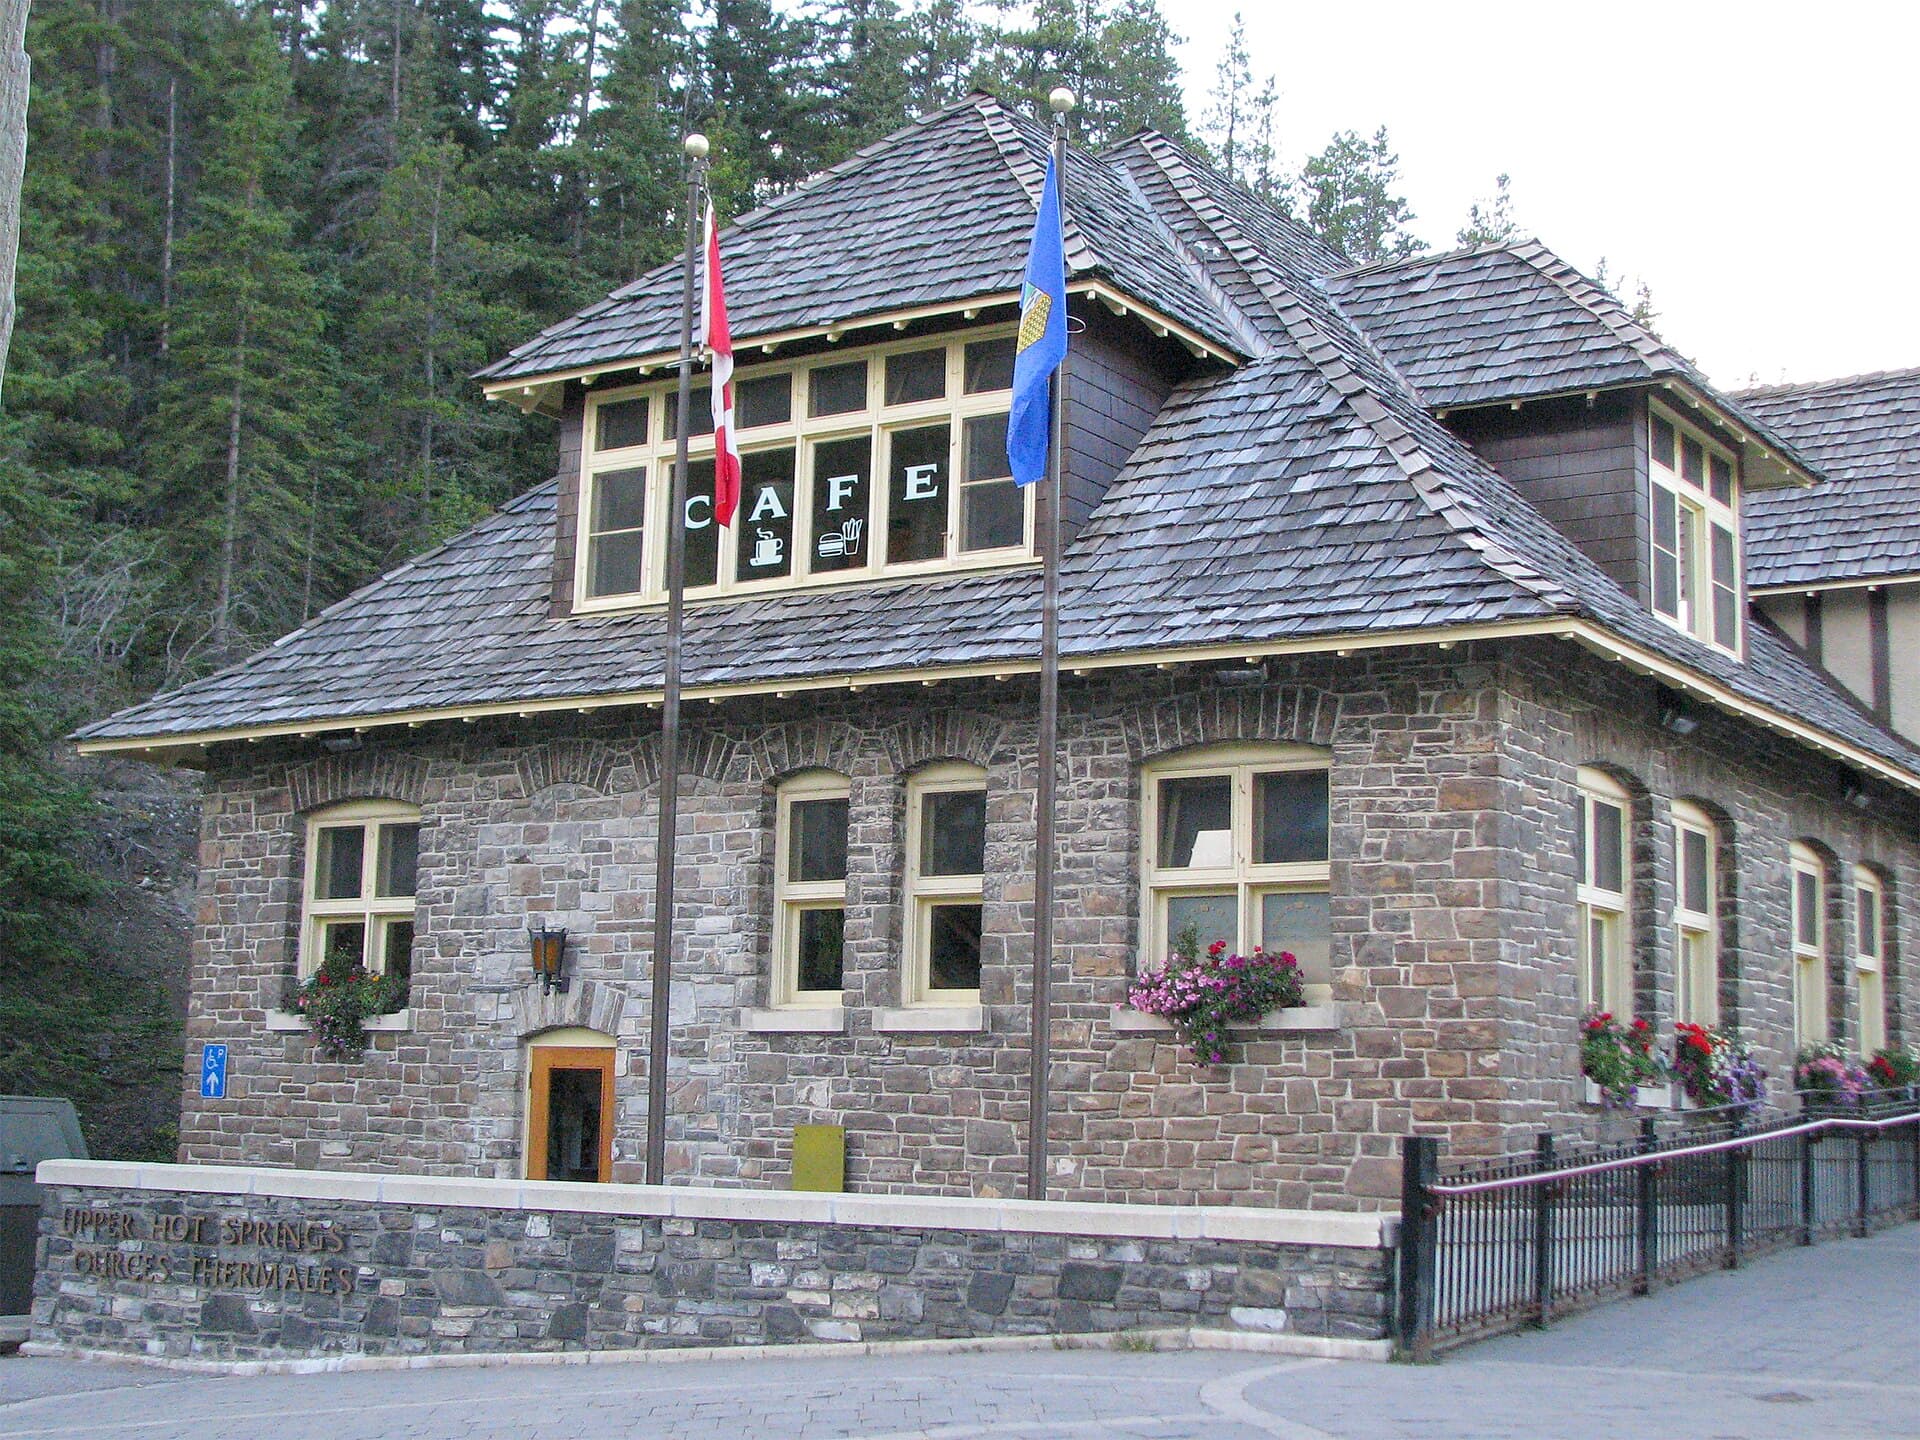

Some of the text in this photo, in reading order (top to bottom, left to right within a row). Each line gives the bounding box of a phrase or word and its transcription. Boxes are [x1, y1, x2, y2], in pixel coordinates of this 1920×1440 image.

[684, 463, 939, 529] CAFE
[63, 1208, 345, 1253] UPPER HOT SPRINGS
[191, 1256, 354, 1297] THERMALES
